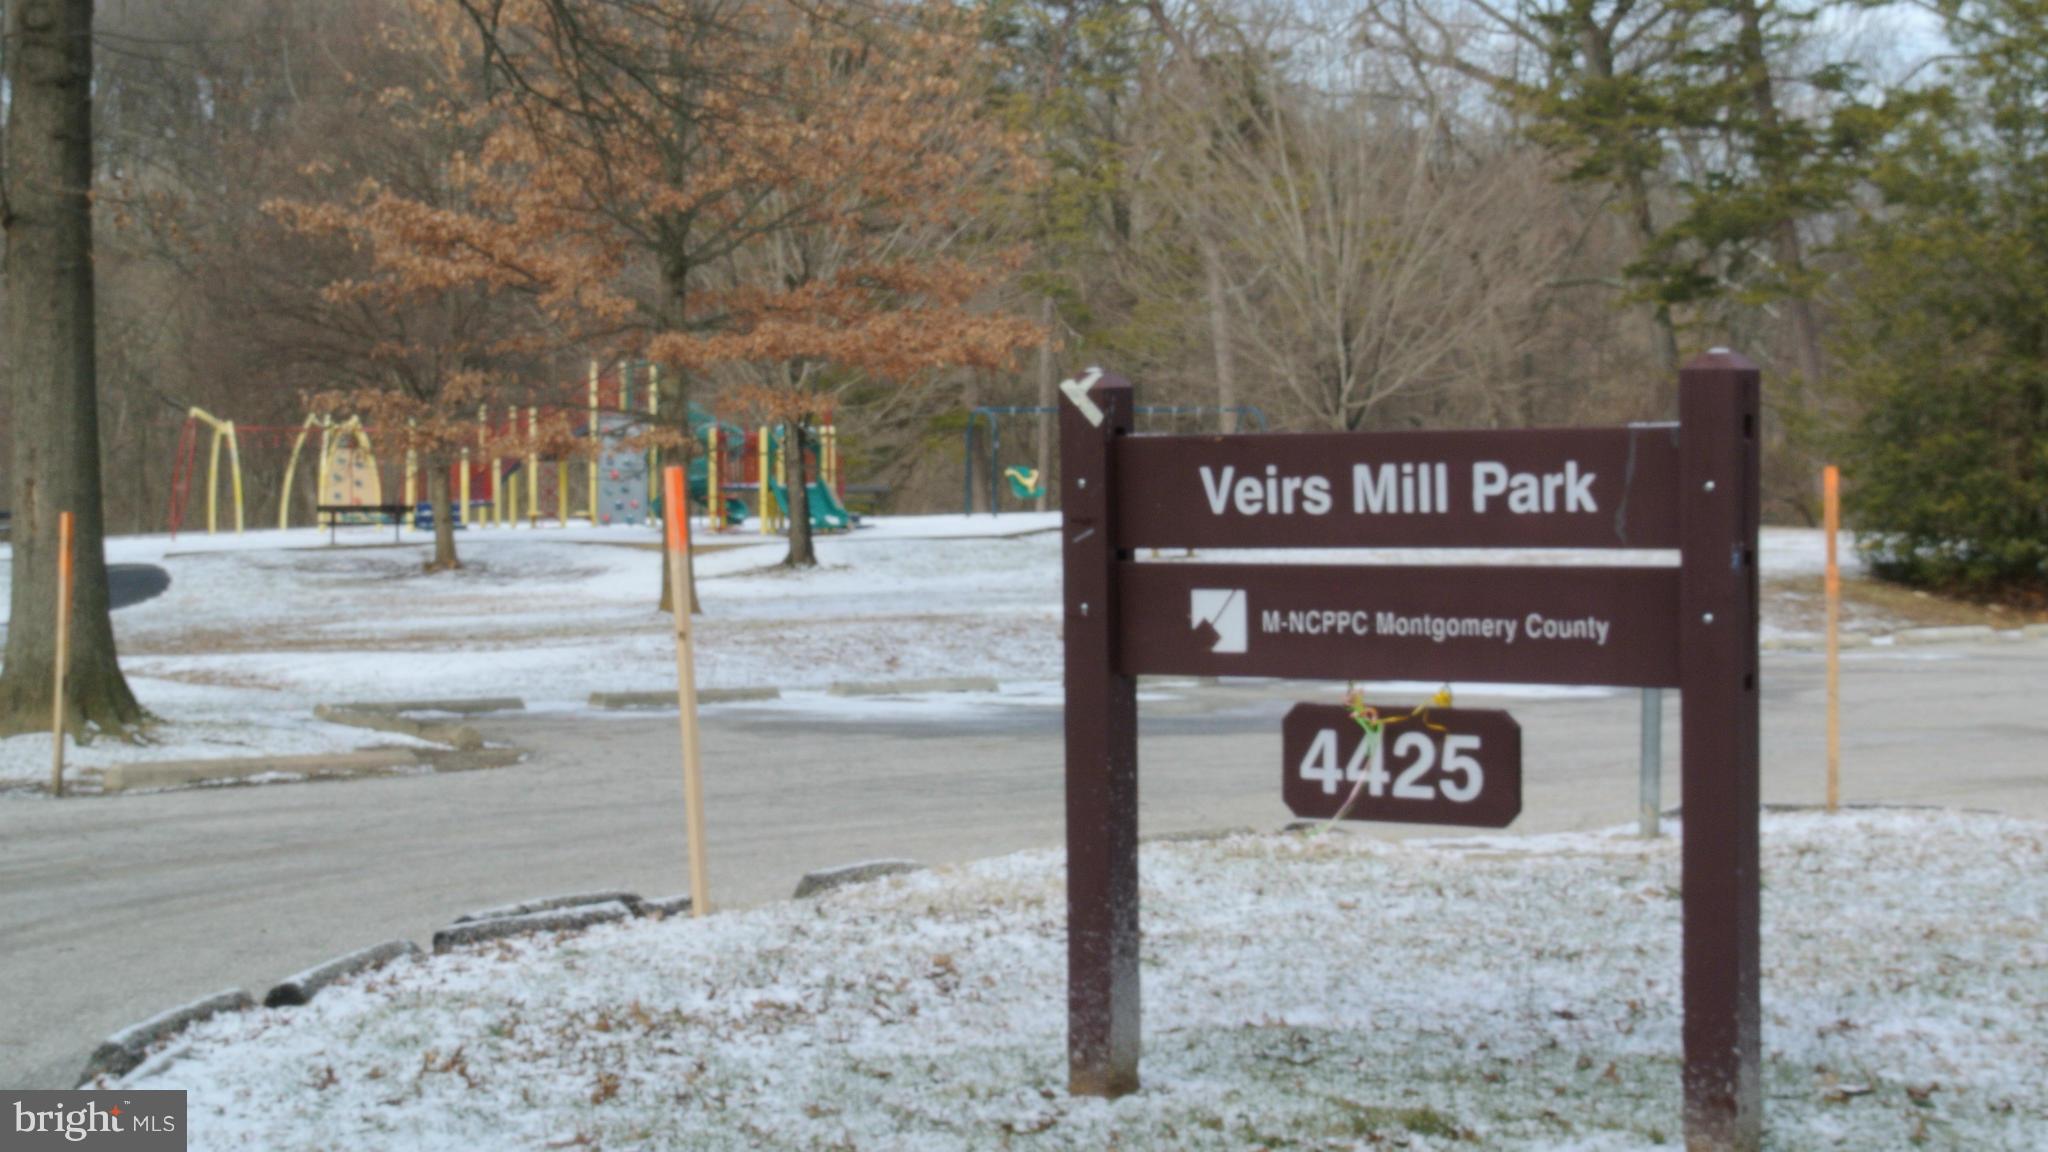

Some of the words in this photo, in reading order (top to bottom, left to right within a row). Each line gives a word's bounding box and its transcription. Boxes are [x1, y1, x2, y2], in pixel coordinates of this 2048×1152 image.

[1200, 465, 1332, 515] Veirs
[1353, 462, 1448, 514] Mill
[1473, 460, 1598, 513] Park
[1262, 610, 1368, 636] M-NCPPC
[1376, 612, 1517, 644] Montgomery
[1525, 614, 1610, 646] County
[1300, 728, 1484, 803] 4425
